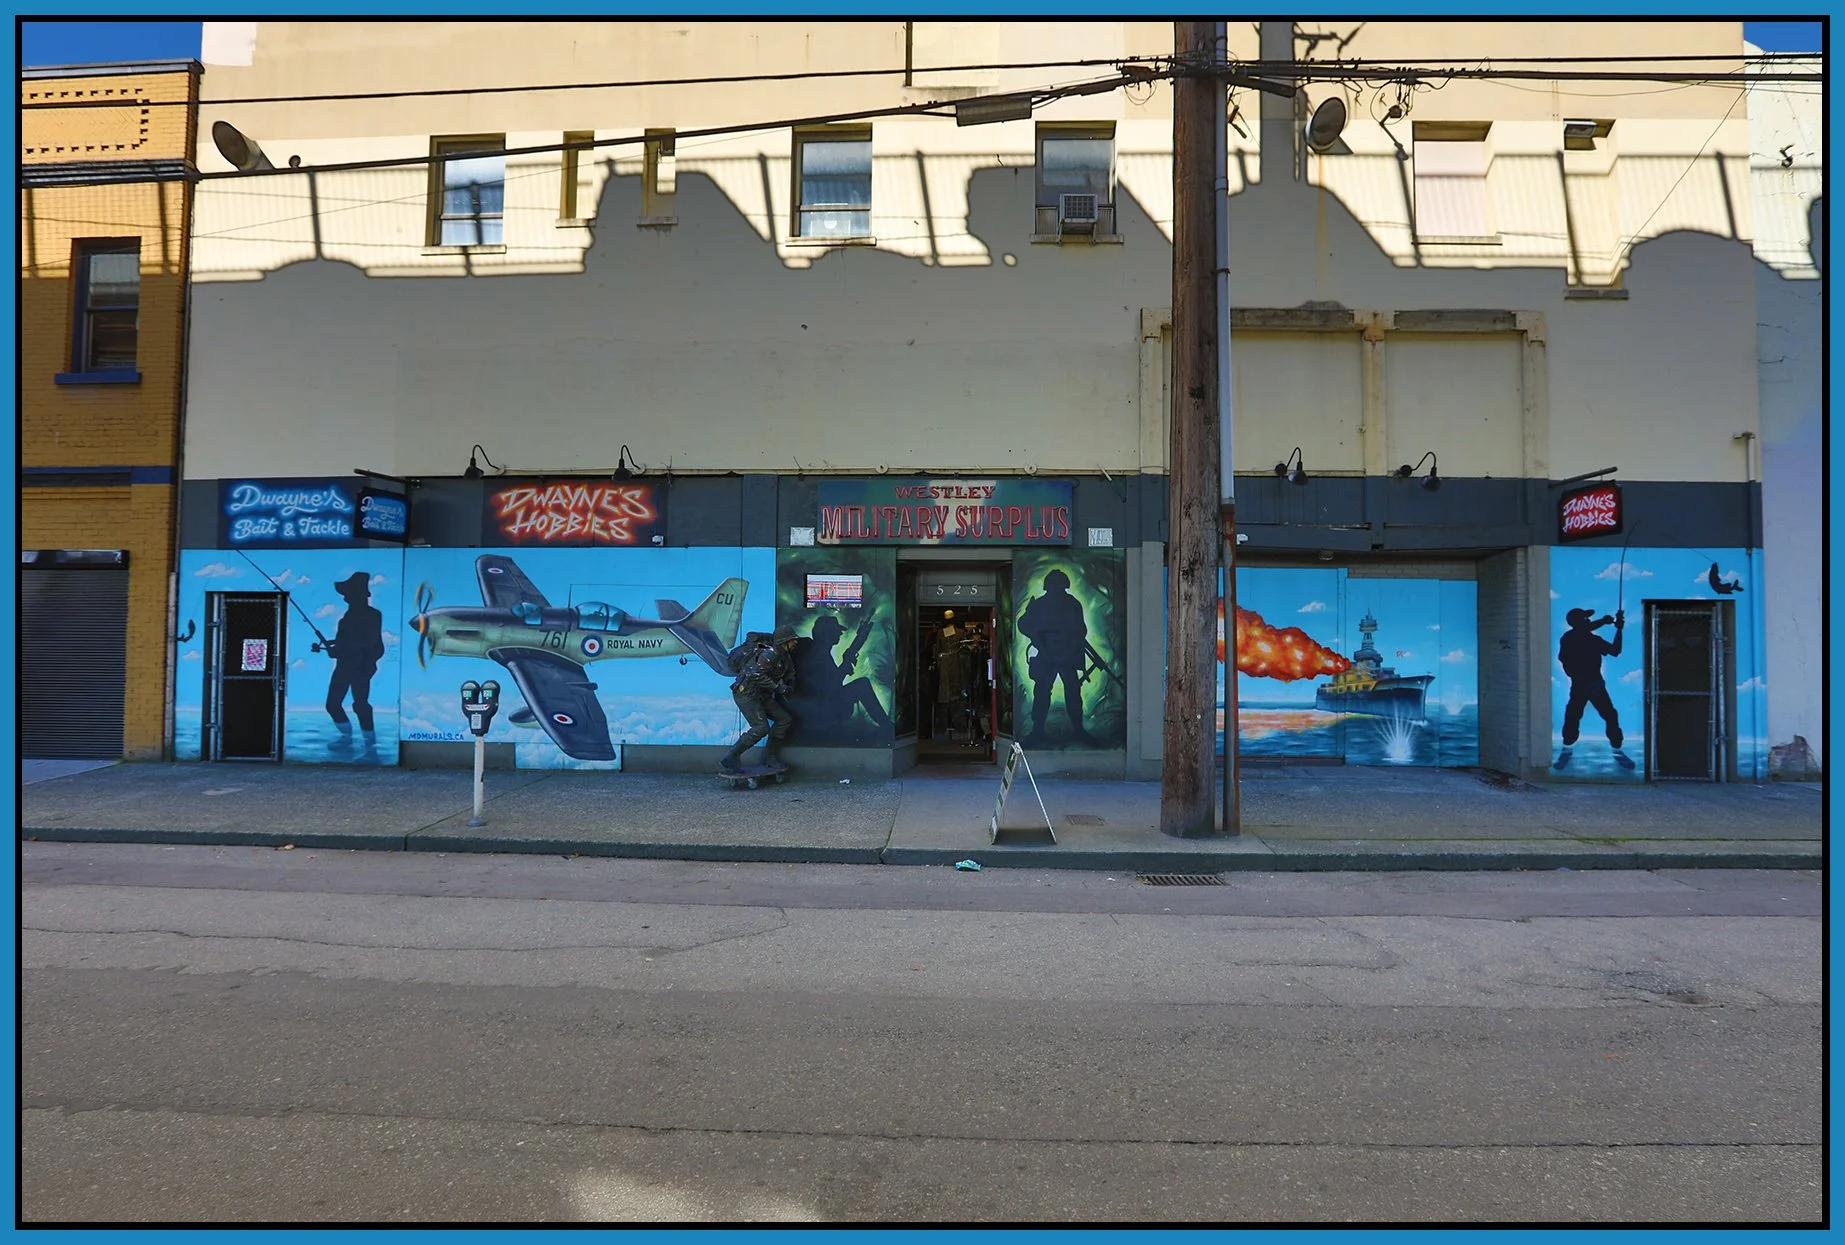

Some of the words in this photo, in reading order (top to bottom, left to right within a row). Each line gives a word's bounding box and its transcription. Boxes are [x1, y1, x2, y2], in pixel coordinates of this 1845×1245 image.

[230, 485, 351, 516] Dwayne's
[501, 485, 650, 518] DWAYNE'S
[895, 485, 995, 499] WESTLEY
[1563, 494, 1616, 516] DWAYNE'S
[234, 517, 279, 539] Bait
[284, 522, 295, 536] &
[300, 517, 350, 535] Tackle
[820, 505, 949, 539] MILITARY
[955, 505, 1069, 539] SURPLUS
[716, 592, 734, 606] CU
[936, 584, 978, 596] 525
[541, 630, 569, 650] 761
[607, 639, 634, 649] ROYAL
[638, 639, 663, 649] NAVY
